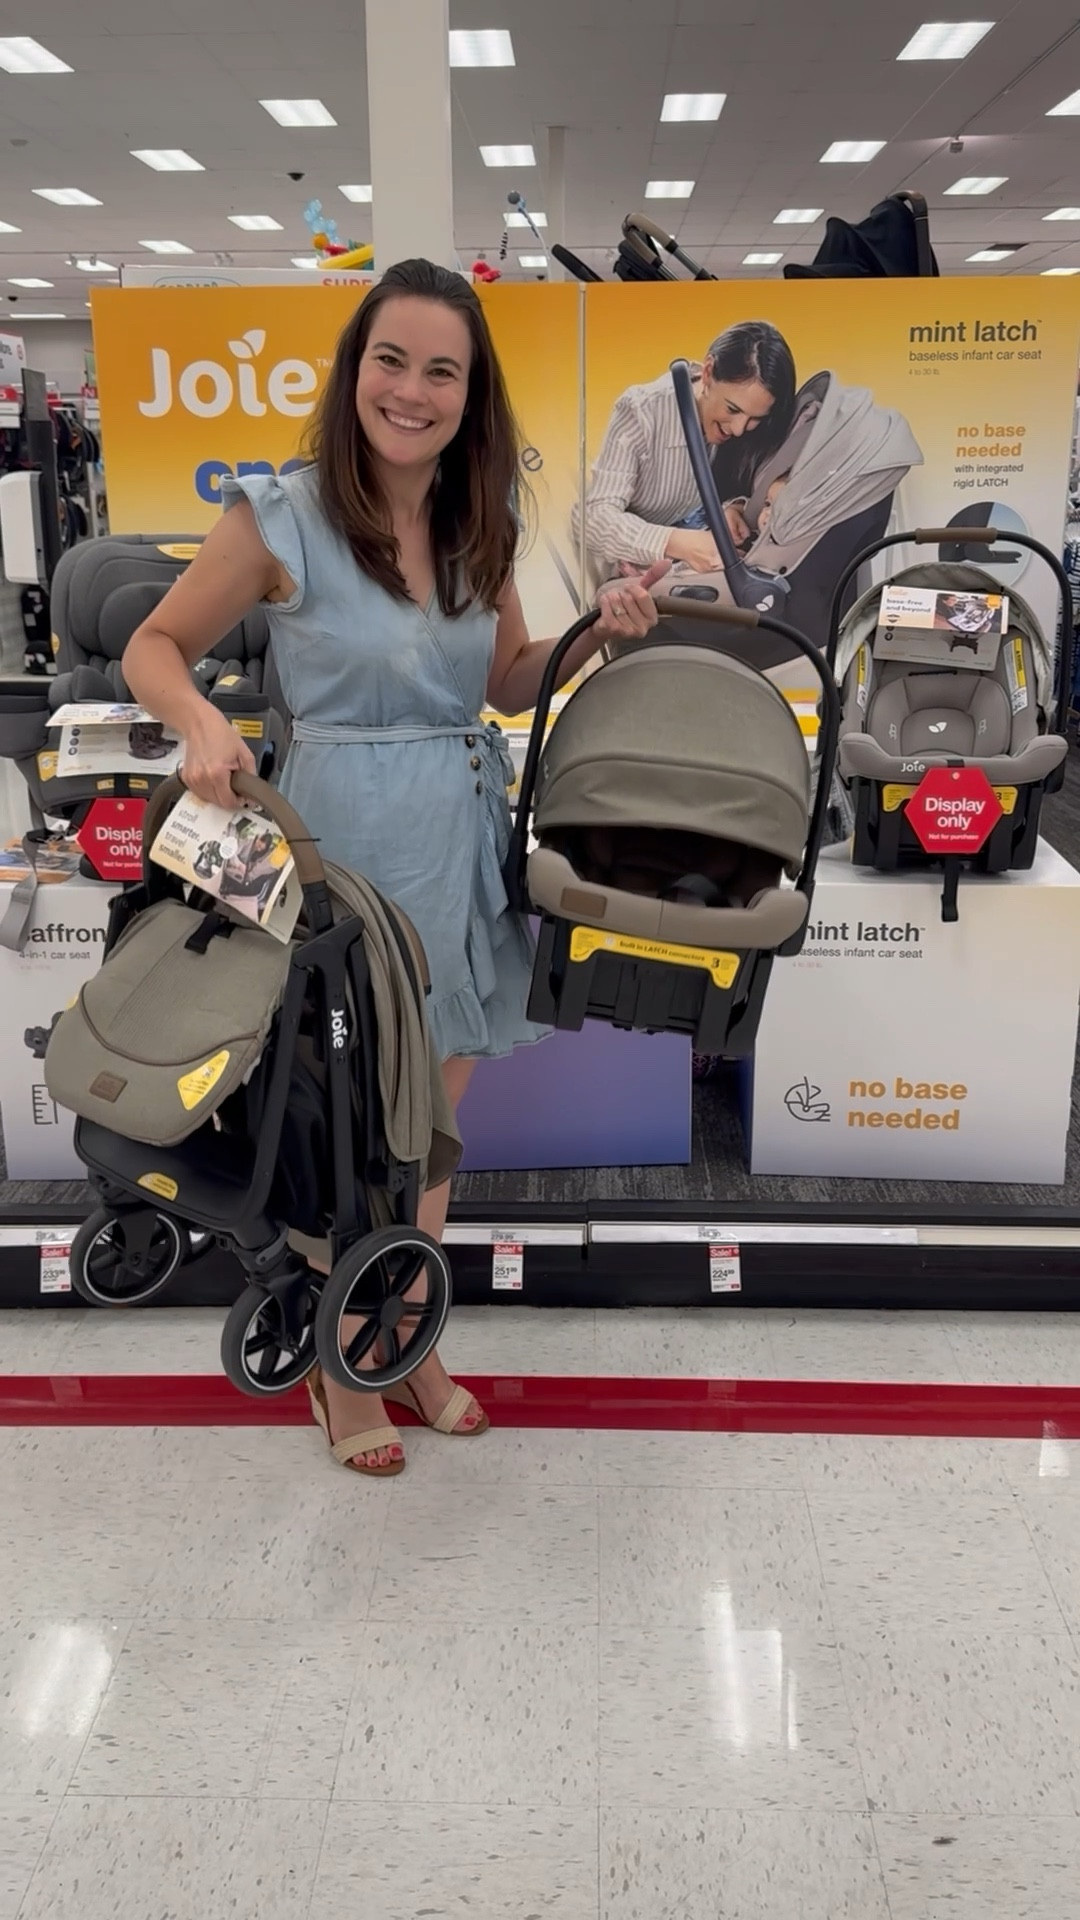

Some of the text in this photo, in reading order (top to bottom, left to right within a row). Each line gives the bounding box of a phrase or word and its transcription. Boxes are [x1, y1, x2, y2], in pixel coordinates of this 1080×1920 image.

[909, 320, 967, 343] mint
[909, 350, 1042, 362] baseless infant car seat
[138, 329, 318, 419] Joie
[957, 423, 1026, 438] no base
[956, 442, 1022, 457] needed
[954, 464, 1024, 474] with integrated
[953, 478, 1009, 490] rigid LATCH
[901, 760, 926, 773] Joie
[925, 797, 986, 815] Display
[937, 814, 972, 831] only
[96, 826, 143, 843] Displa
[27, 923, 106, 943] affron
[19, 951, 91, 960] 4-in-1 car seat
[643, 946, 668, 956] LATCH
[799, 947, 923, 959] aseless infant car seat
[331, 1008, 348, 1049] Joie
[849, 1077, 968, 1100] no base
[848, 1108, 960, 1130] needed
